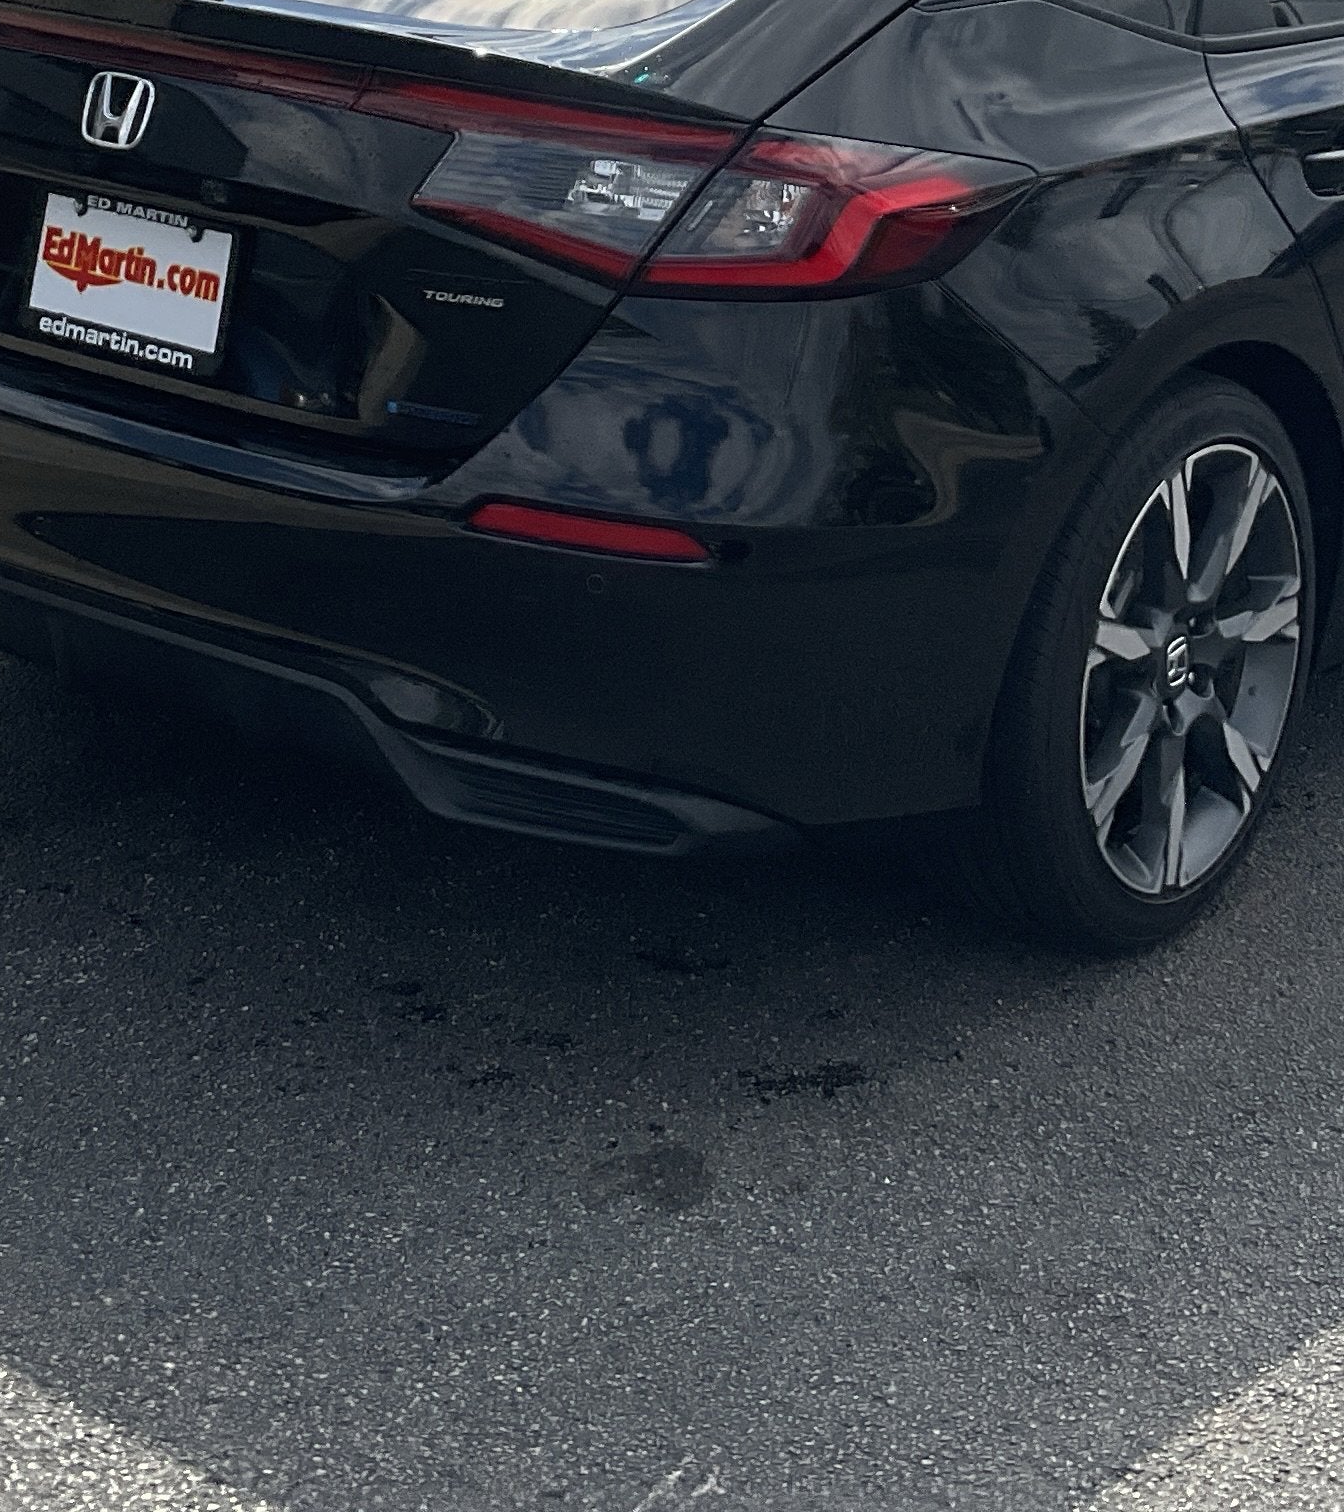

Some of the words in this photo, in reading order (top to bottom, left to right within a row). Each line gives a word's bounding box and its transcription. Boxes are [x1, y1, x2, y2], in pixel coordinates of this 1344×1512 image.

[87, 194, 111, 210] ED
[116, 201, 189, 228] MARTIN
[42, 225, 221, 303] EdMartin.com
[423, 289, 504, 308] TOURING
[39, 316, 193, 369] edmartin.com
